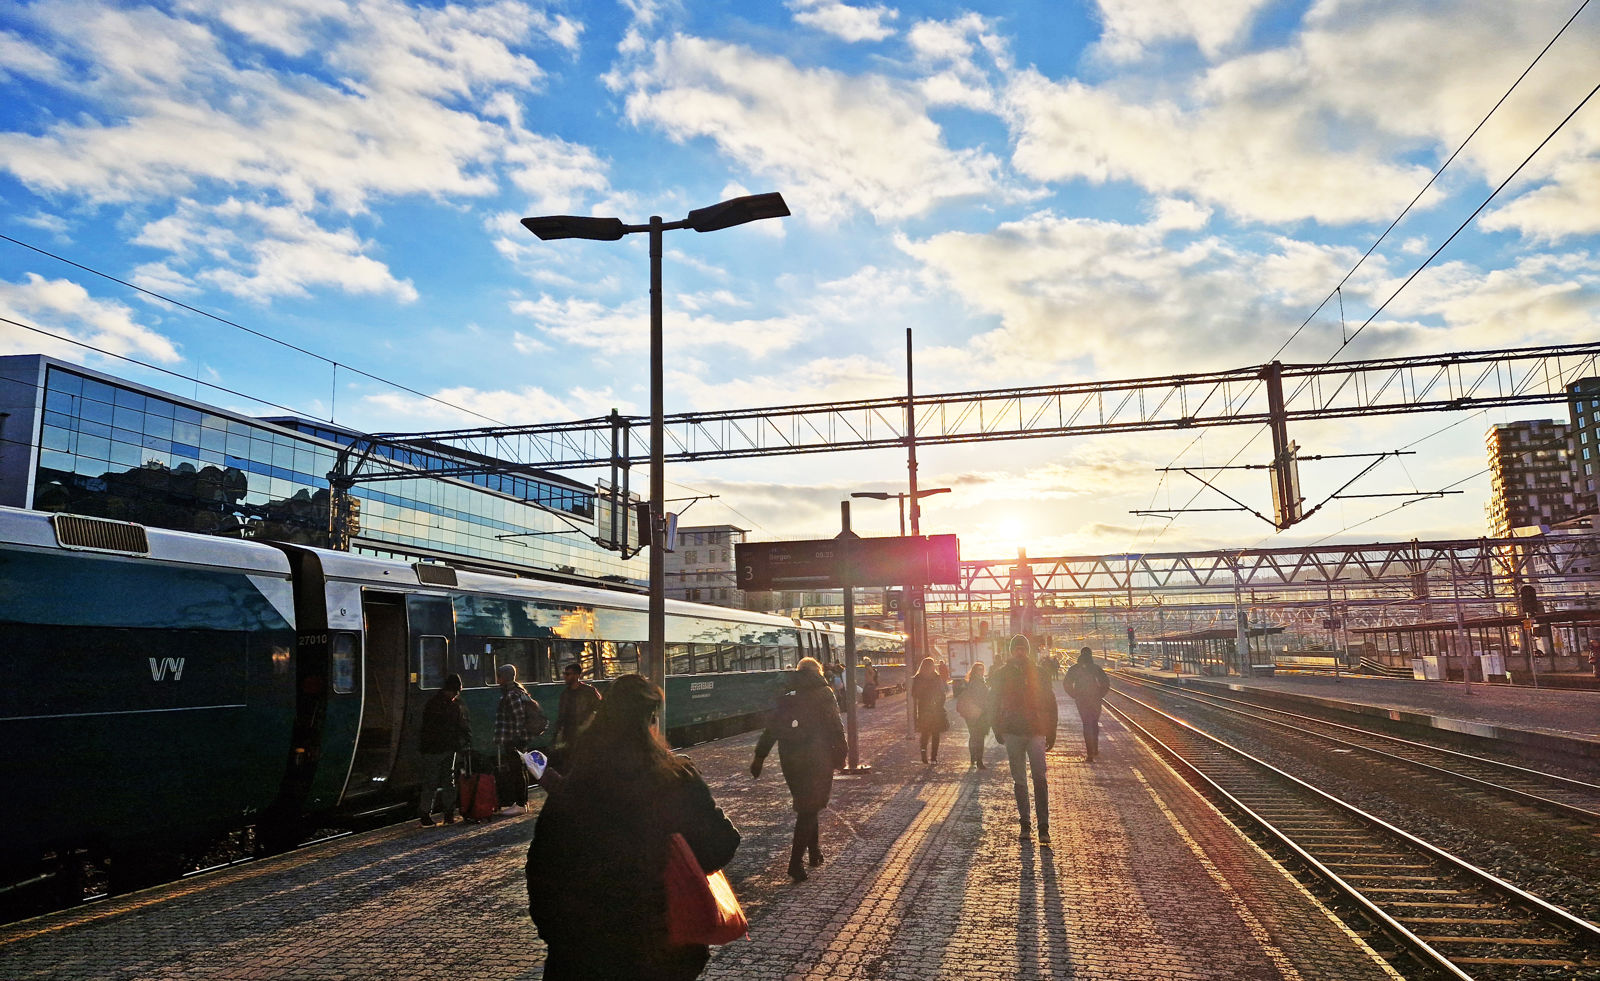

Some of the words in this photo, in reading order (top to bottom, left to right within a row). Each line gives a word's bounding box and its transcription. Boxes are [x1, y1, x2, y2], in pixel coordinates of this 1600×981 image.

[744, 566, 754, 581] 3
[889, 599, 898, 609] G
[912, 598, 921, 608] G
[298, 633, 328, 646] 27010
